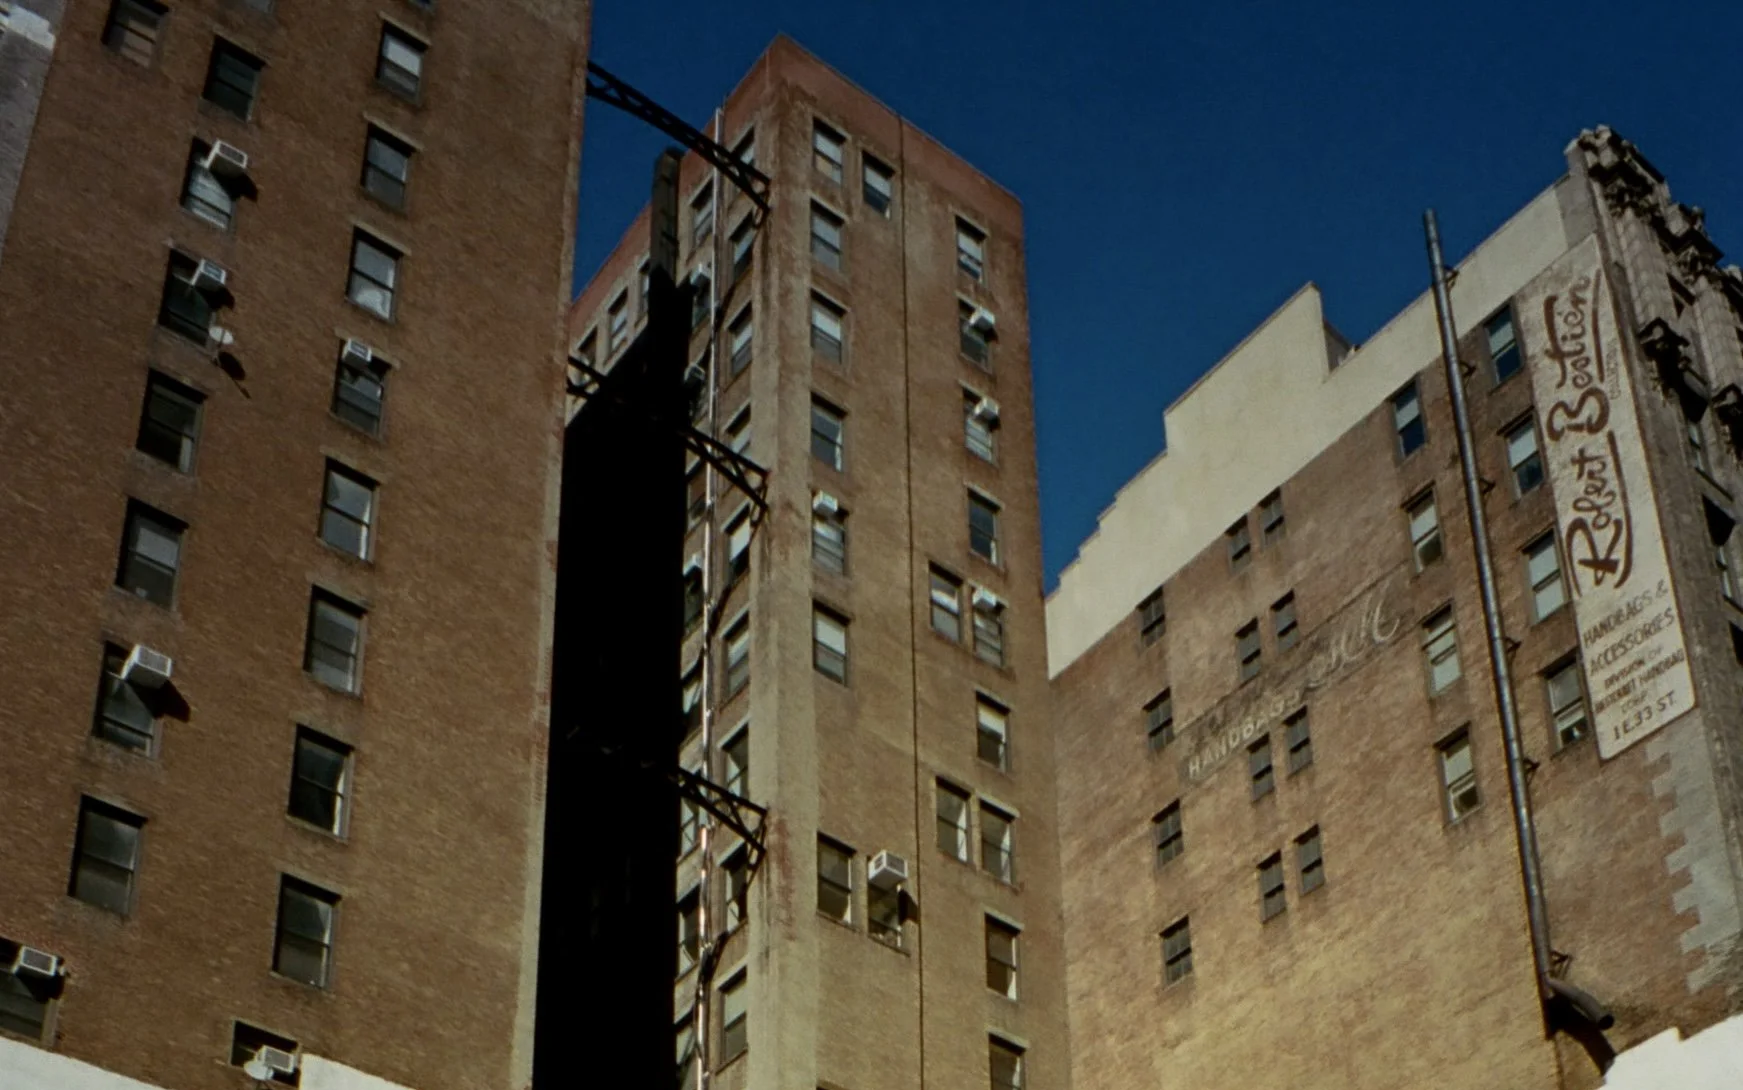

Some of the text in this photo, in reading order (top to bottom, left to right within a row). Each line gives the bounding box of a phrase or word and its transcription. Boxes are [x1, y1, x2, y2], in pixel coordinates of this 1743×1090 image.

[1566, 447, 1632, 597] Robert
[1583, 579, 1668, 649] HANDBAGS &
[1590, 607, 1674, 676] ACCESSORIES
